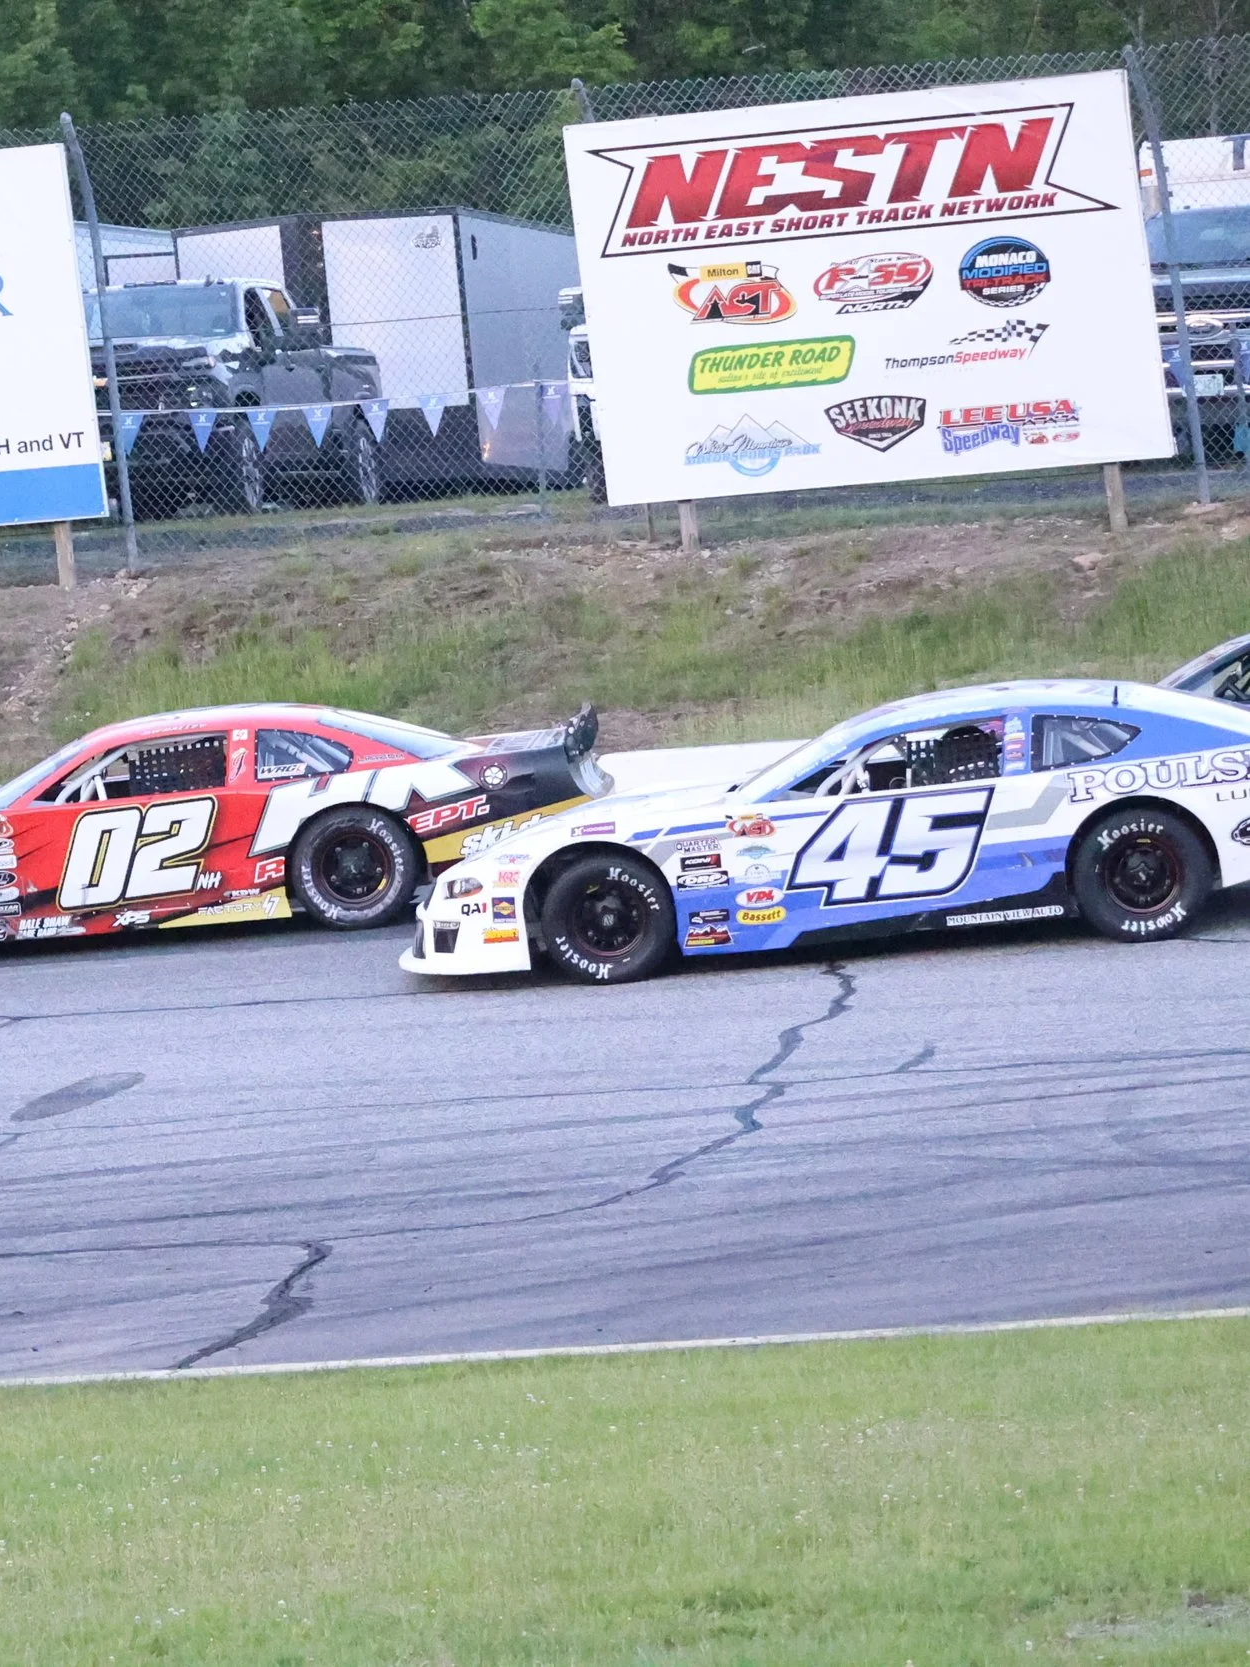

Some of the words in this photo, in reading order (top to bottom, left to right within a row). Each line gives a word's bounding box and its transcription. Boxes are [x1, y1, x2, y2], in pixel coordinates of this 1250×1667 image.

[626, 116, 1054, 229] NESTN
[621, 225, 698, 248] NORTH
[705, 220, 766, 240] EAST
[770, 213, 849, 233] SHORT
[856, 204, 934, 225] TRACK
[940, 192, 1058, 217] NETWORK
[707, 267, 739, 278] Milton
[962, 262, 1047, 279] MODIFIED
[975, 251, 1036, 268] MONACO
[982, 285, 1026, 295] SERIES
[841, 299, 913, 313] NORTH
[700, 351, 785, 373] THUNDER
[789, 346, 841, 366] ROAD
[829, 397, 923, 428] SEEKONK
[940, 405, 1004, 426] LEE
[1006, 399, 1076, 420] USA
[17, 434, 53, 453] and
[59, 431, 85, 450] VT
[941, 424, 1020, 454] Speedway
[1065, 750, 1250, 806] POULS
[1216, 787, 1250, 802] LU
[404, 794, 490, 833] EPT.
[366, 818, 404, 872] Hoosier
[676, 839, 717, 851] QUARTER
[786, 785, 995, 908] 45
[1096, 818, 1165, 851] Hoosier
[56, 795, 218, 910] 02
[684, 844, 719, 853] MASTER
[197, 871, 222, 890] NH
[301, 864, 343, 920] Hoosier
[606, 866, 660, 911] Hoosier
[19, 918, 41, 930] DALE
[43, 915, 71, 929] SHAW
[461, 903, 487, 916] QA1
[742, 910, 781, 921] Bassett
[947, 911, 1002, 925] MOUNTAIN
[1005, 908, 1031, 920] VIEW
[1032, 906, 1062, 918] AUTO
[1121, 901, 1187, 935] Hoosier
[555, 936, 614, 980] Hoosier
